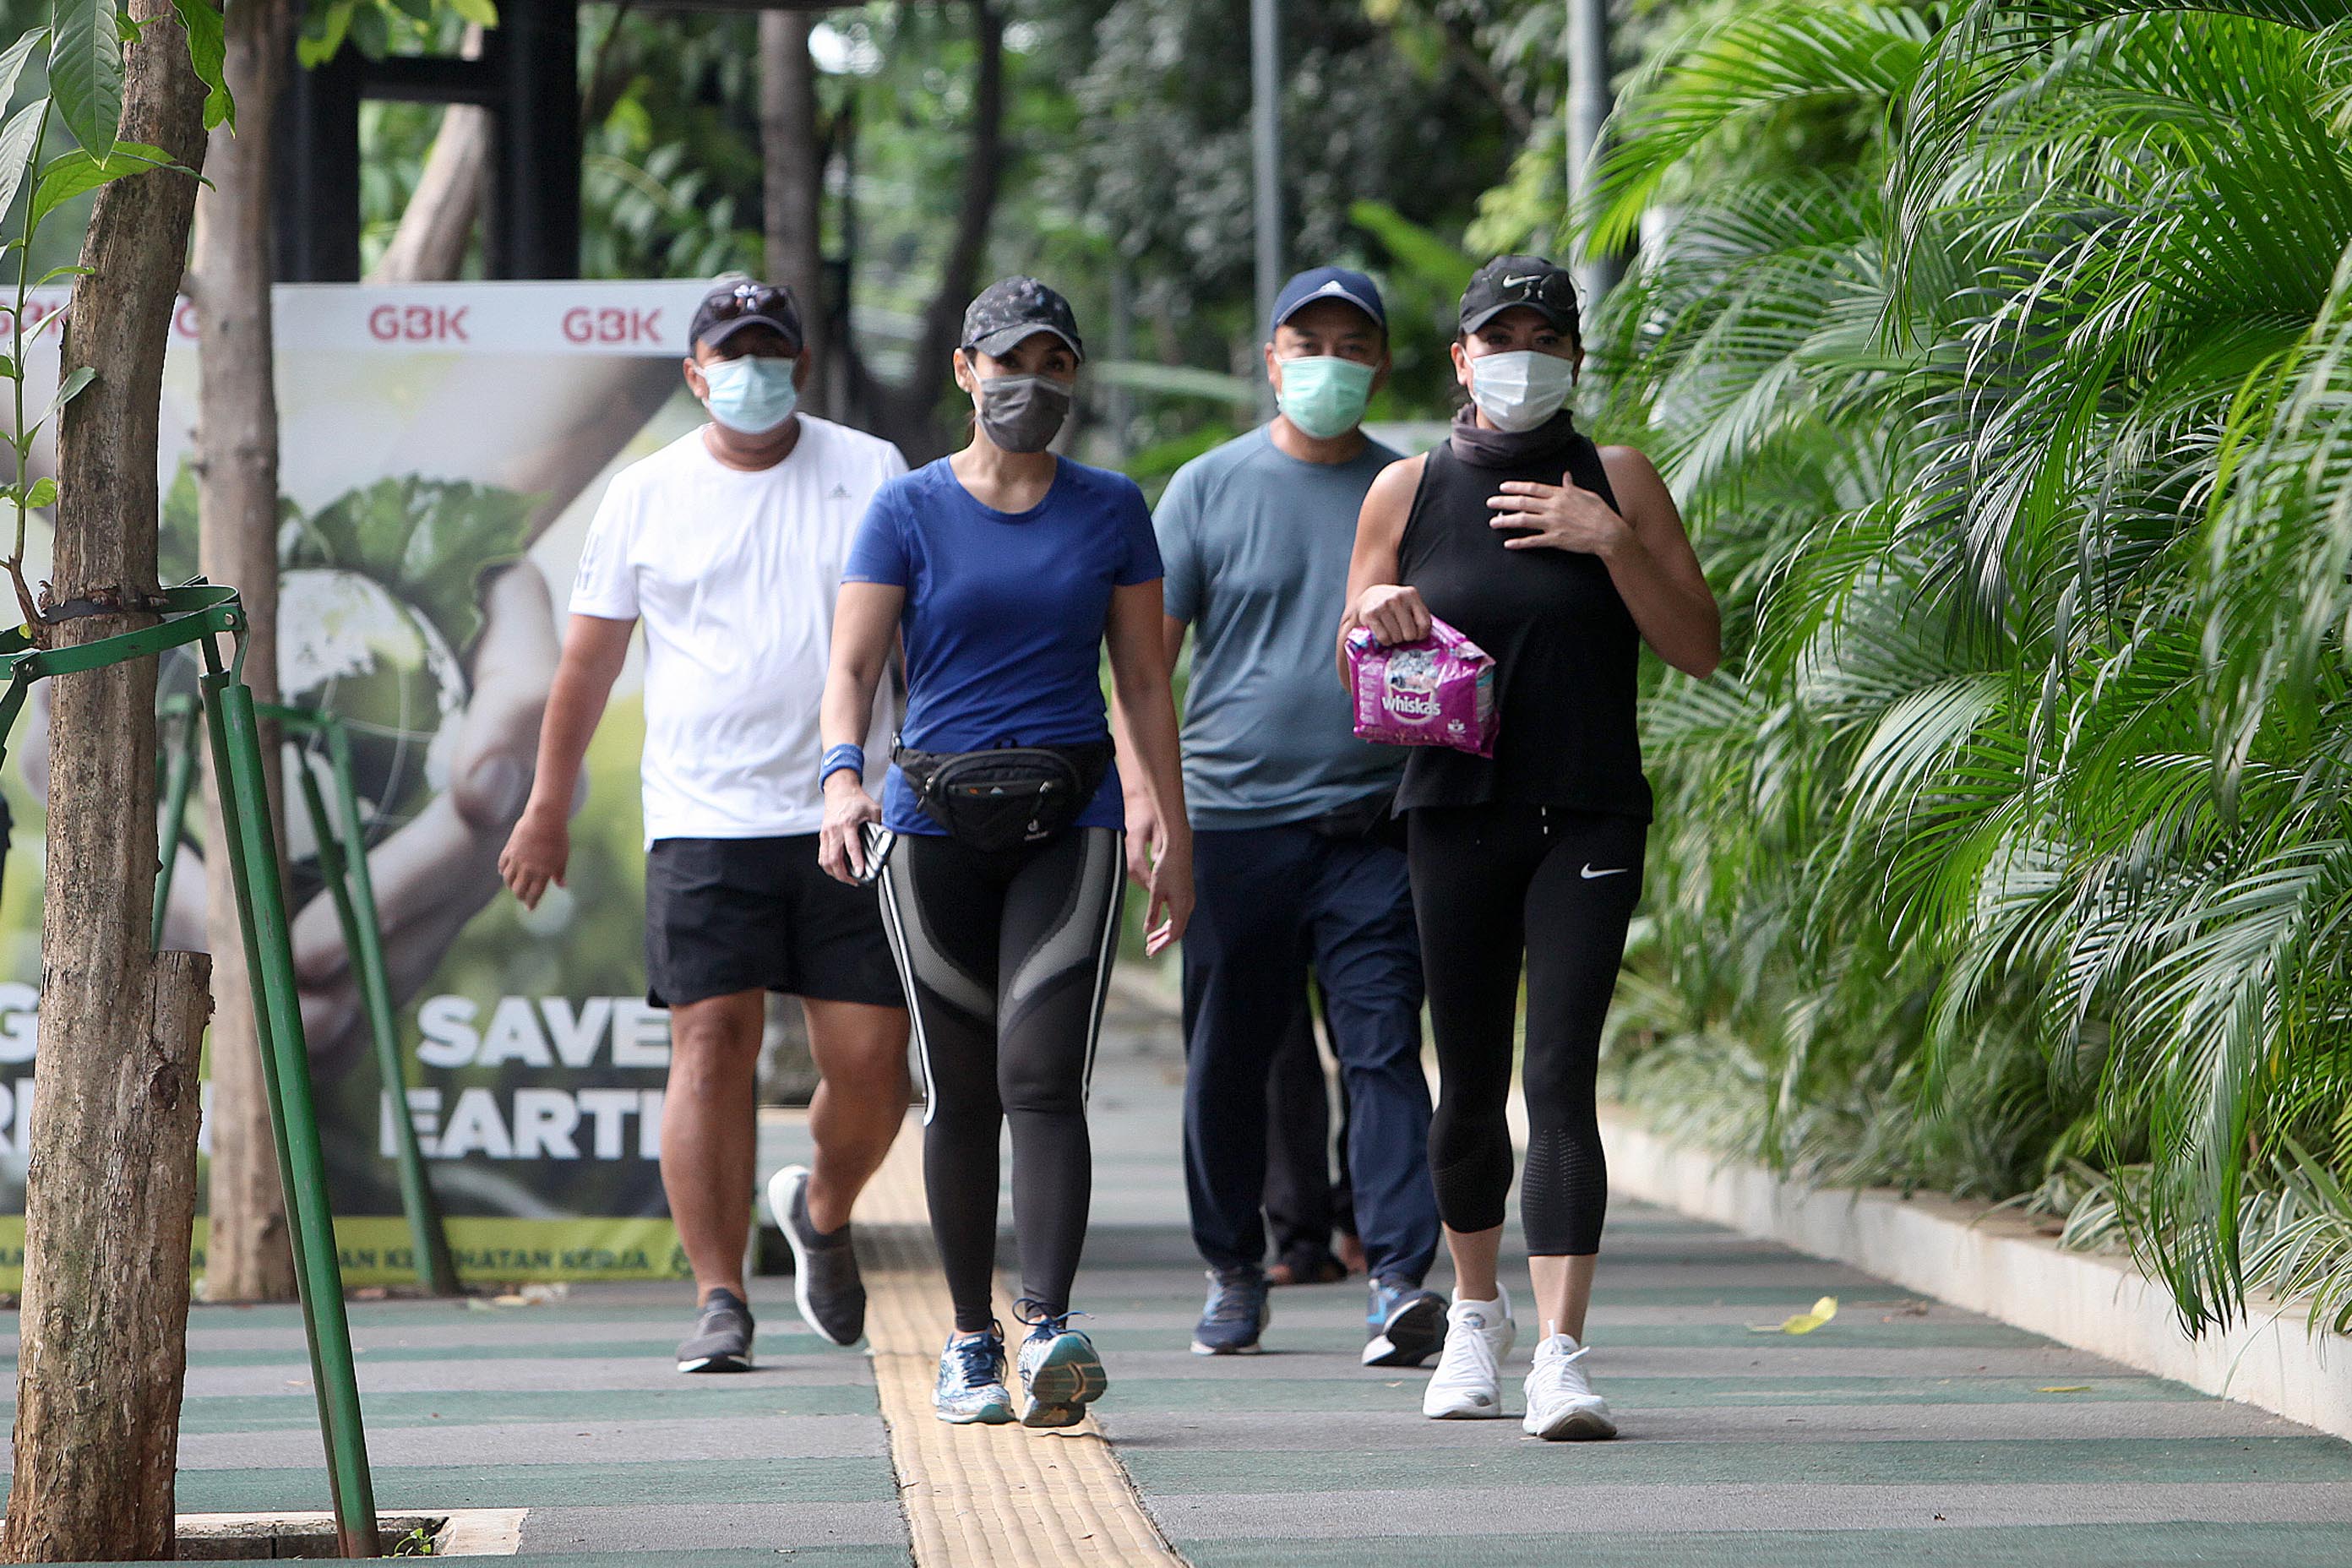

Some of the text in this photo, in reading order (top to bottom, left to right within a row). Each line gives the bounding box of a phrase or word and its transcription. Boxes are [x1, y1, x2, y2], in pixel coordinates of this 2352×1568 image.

[369, 304, 470, 340] GBK
[563, 307, 663, 342] GBK
[1382, 695, 1442, 716] whiskas
[416, 995, 672, 1067] SAVE
